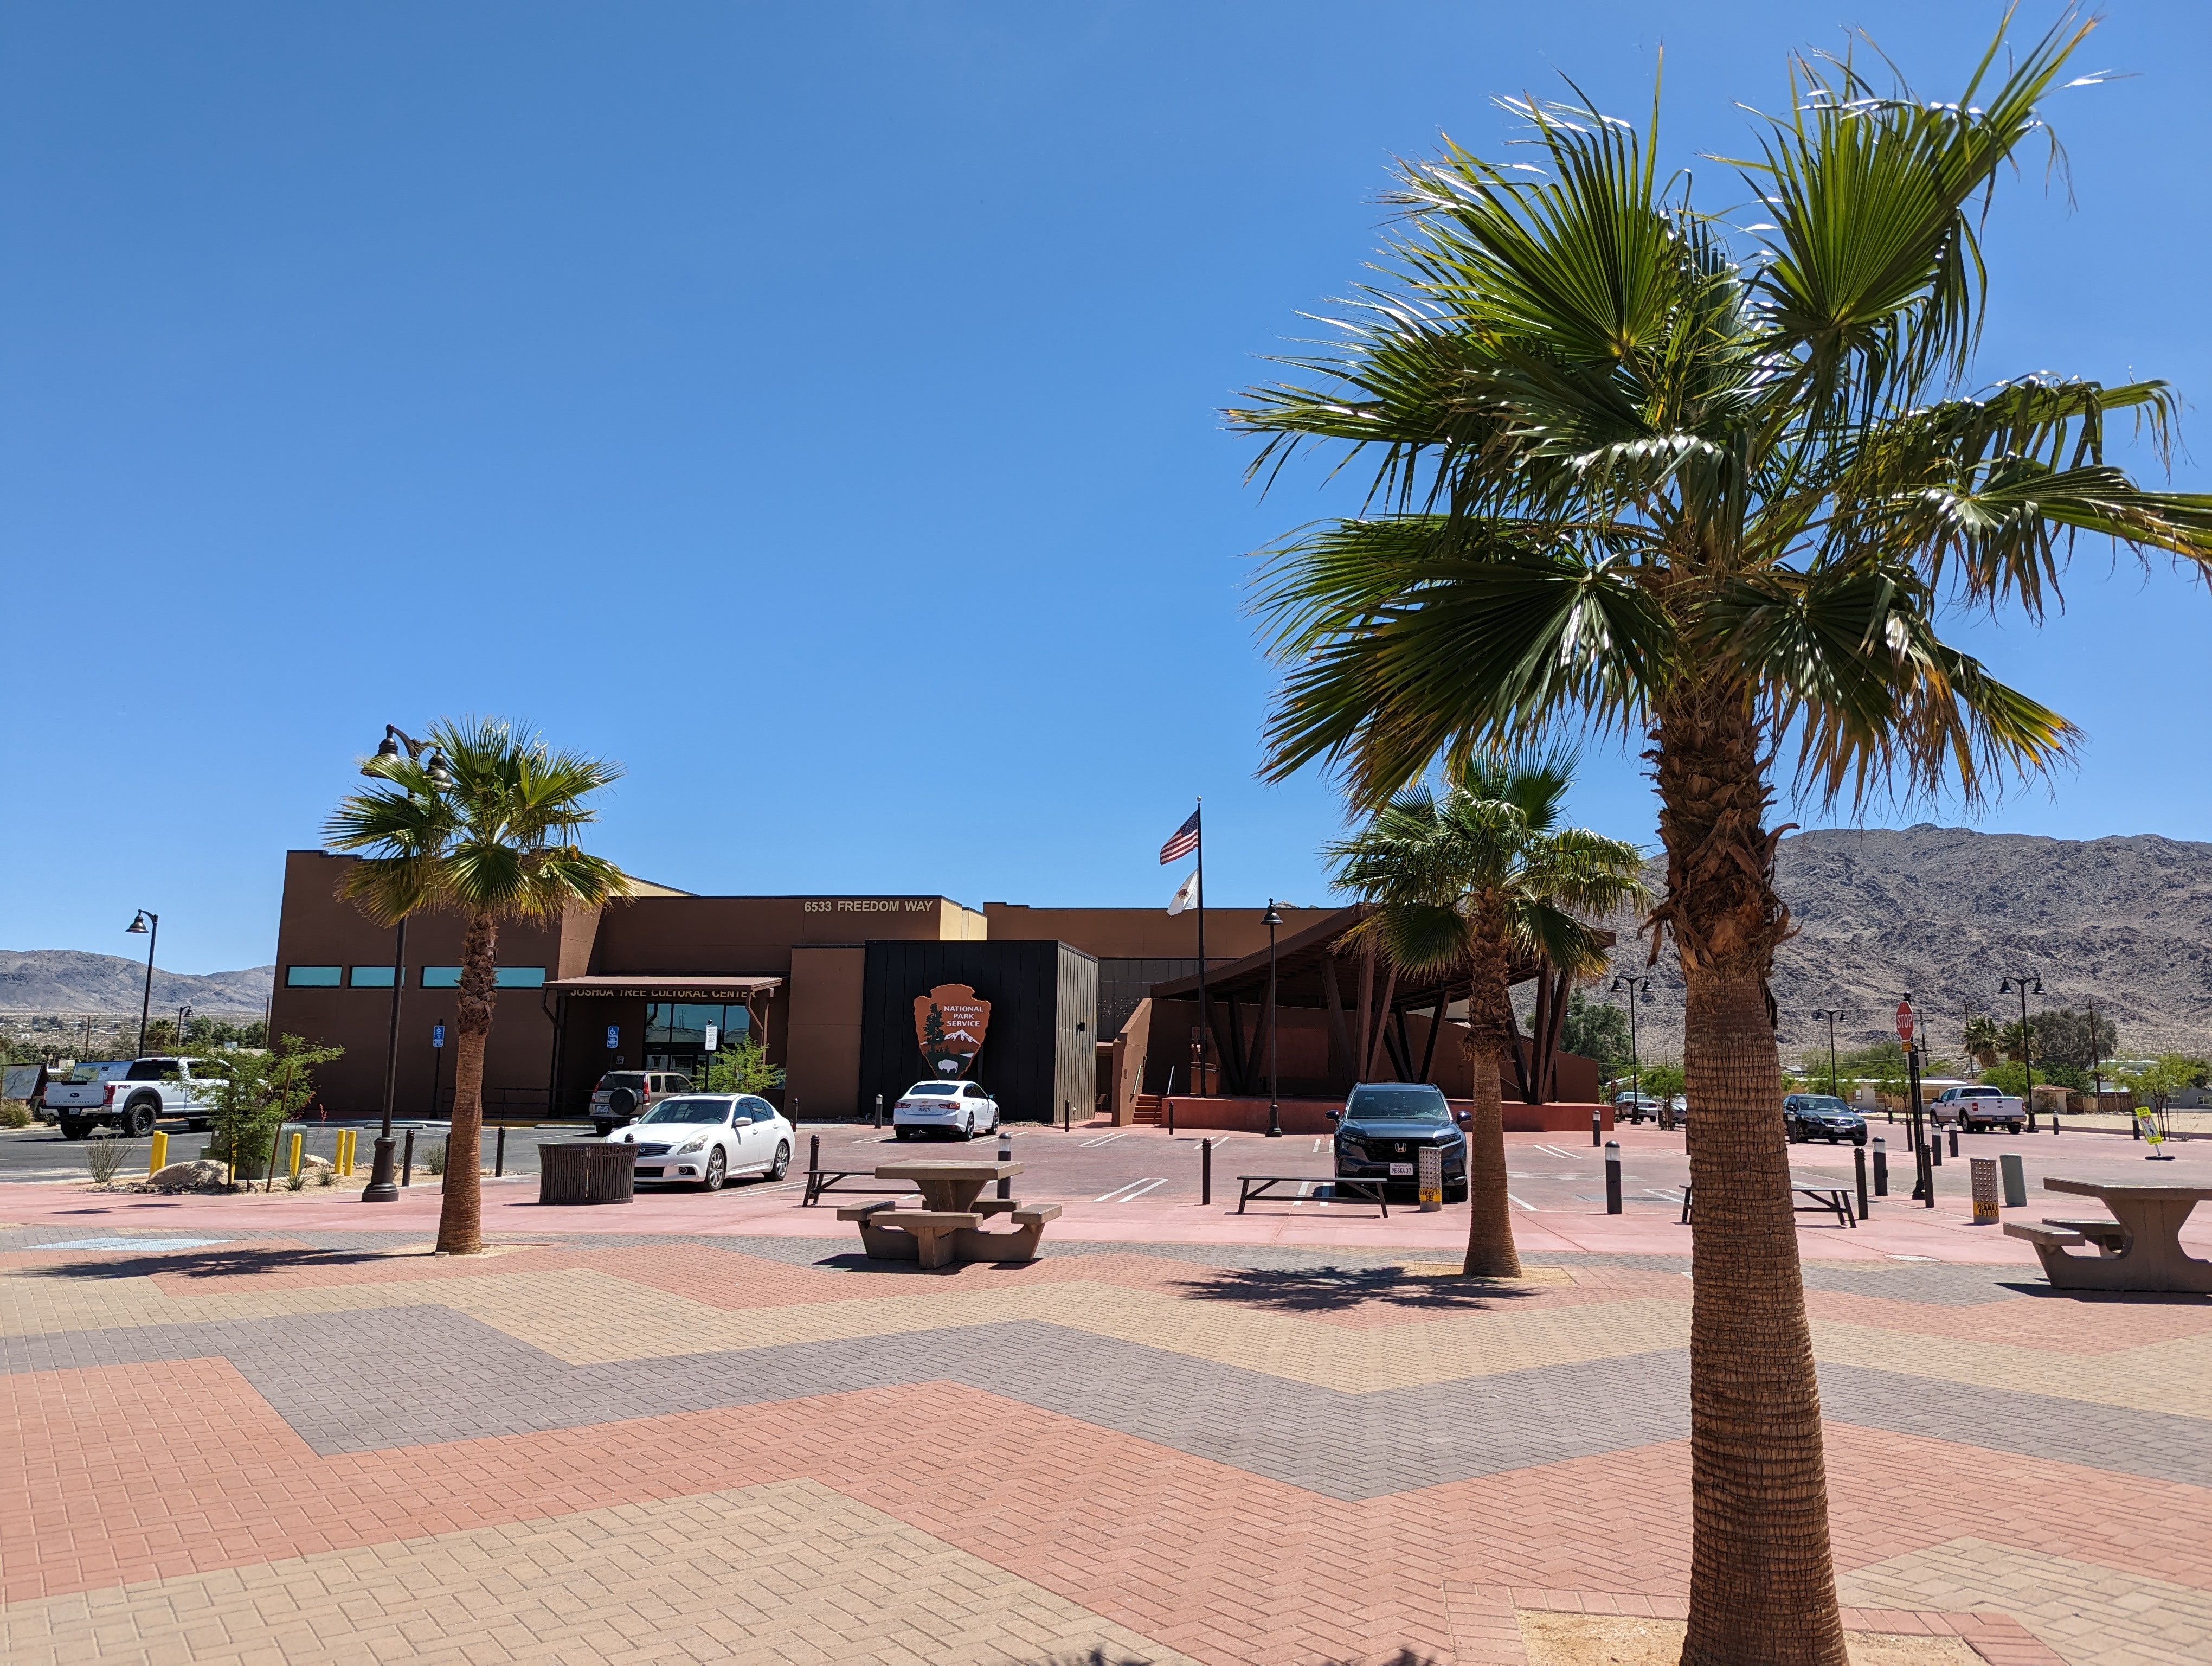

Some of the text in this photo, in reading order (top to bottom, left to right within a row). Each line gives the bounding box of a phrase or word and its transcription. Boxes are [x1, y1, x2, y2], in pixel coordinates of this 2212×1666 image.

[804, 901, 933, 912] 6533 FREEDOM WAY
[1897, 1013, 1912, 1029] STOP
